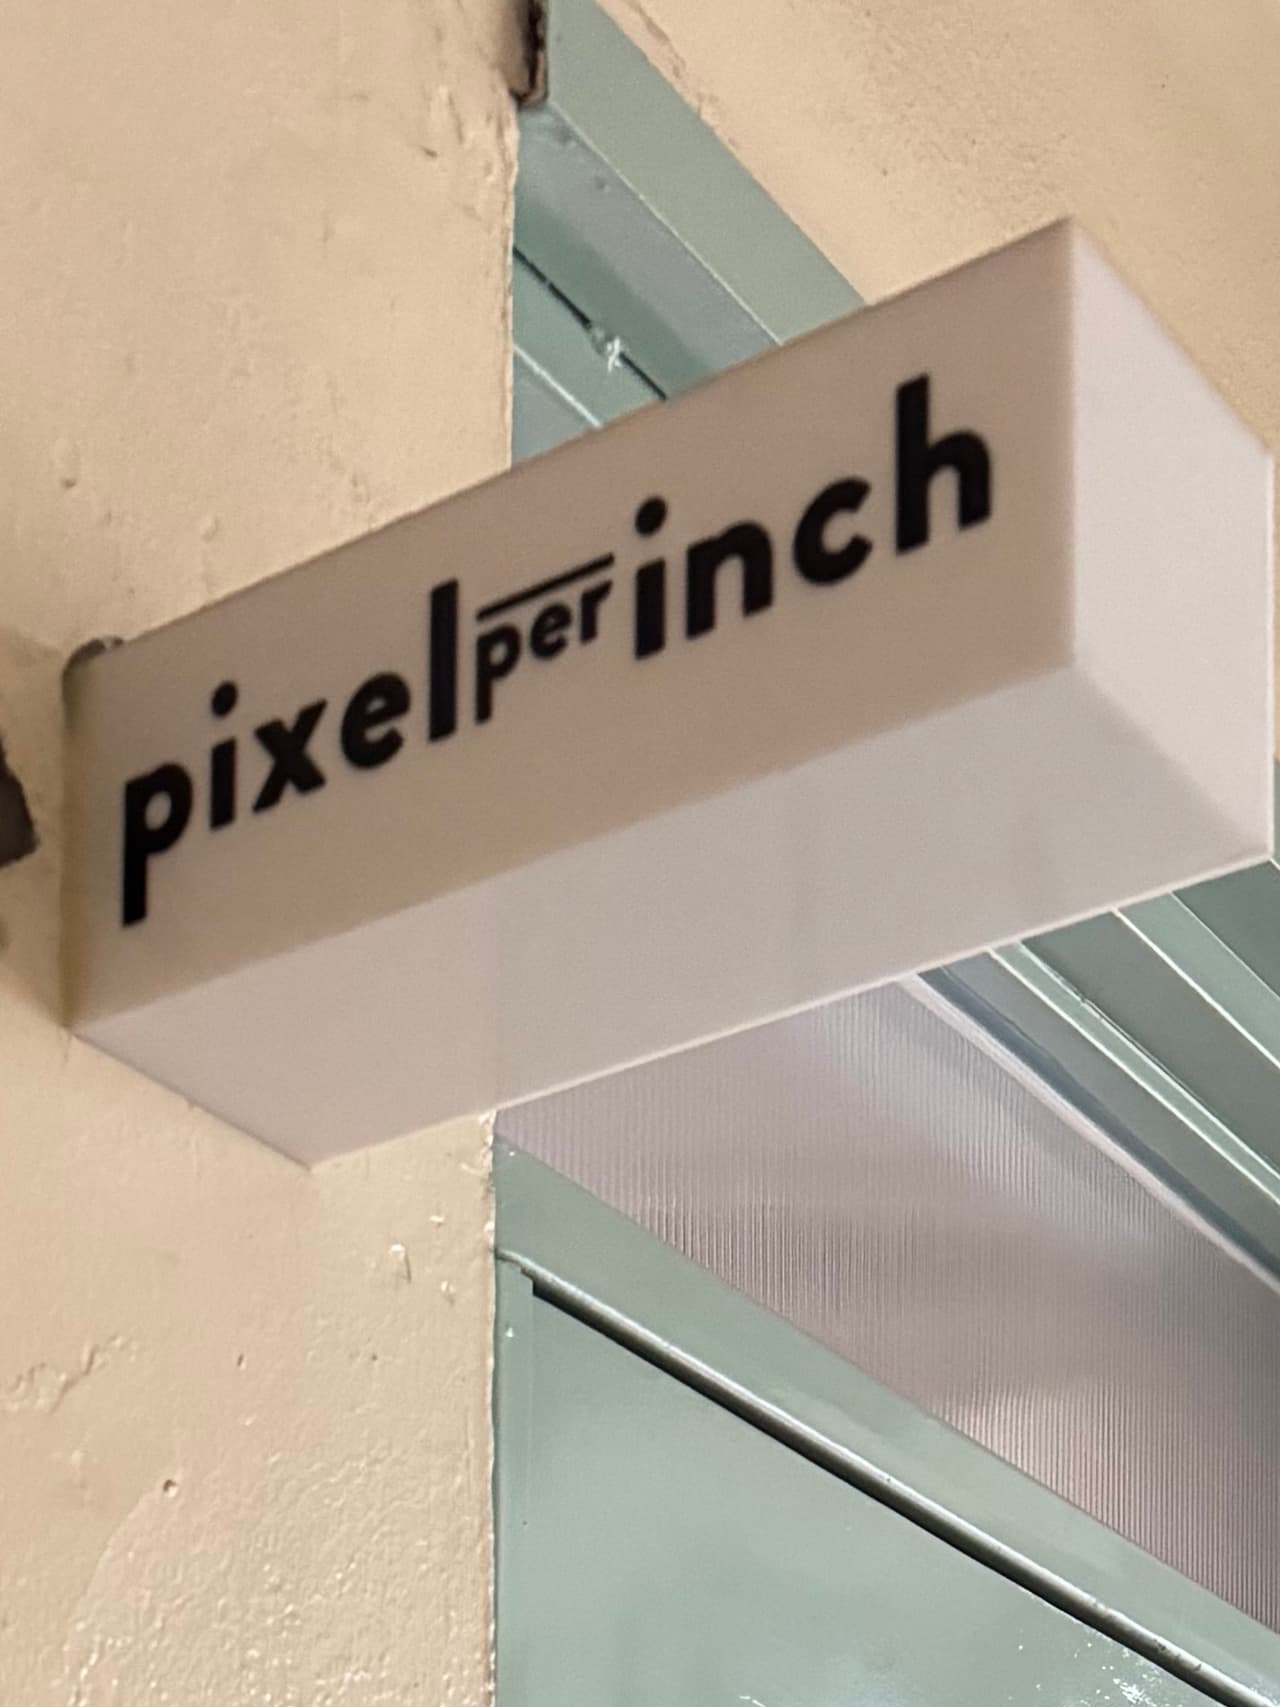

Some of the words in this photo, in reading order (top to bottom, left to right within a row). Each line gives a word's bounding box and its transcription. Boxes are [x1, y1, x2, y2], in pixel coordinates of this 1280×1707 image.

[120, 577, 459, 929] pixel
[475, 579, 613, 725] per
[634, 374, 993, 661] inch
